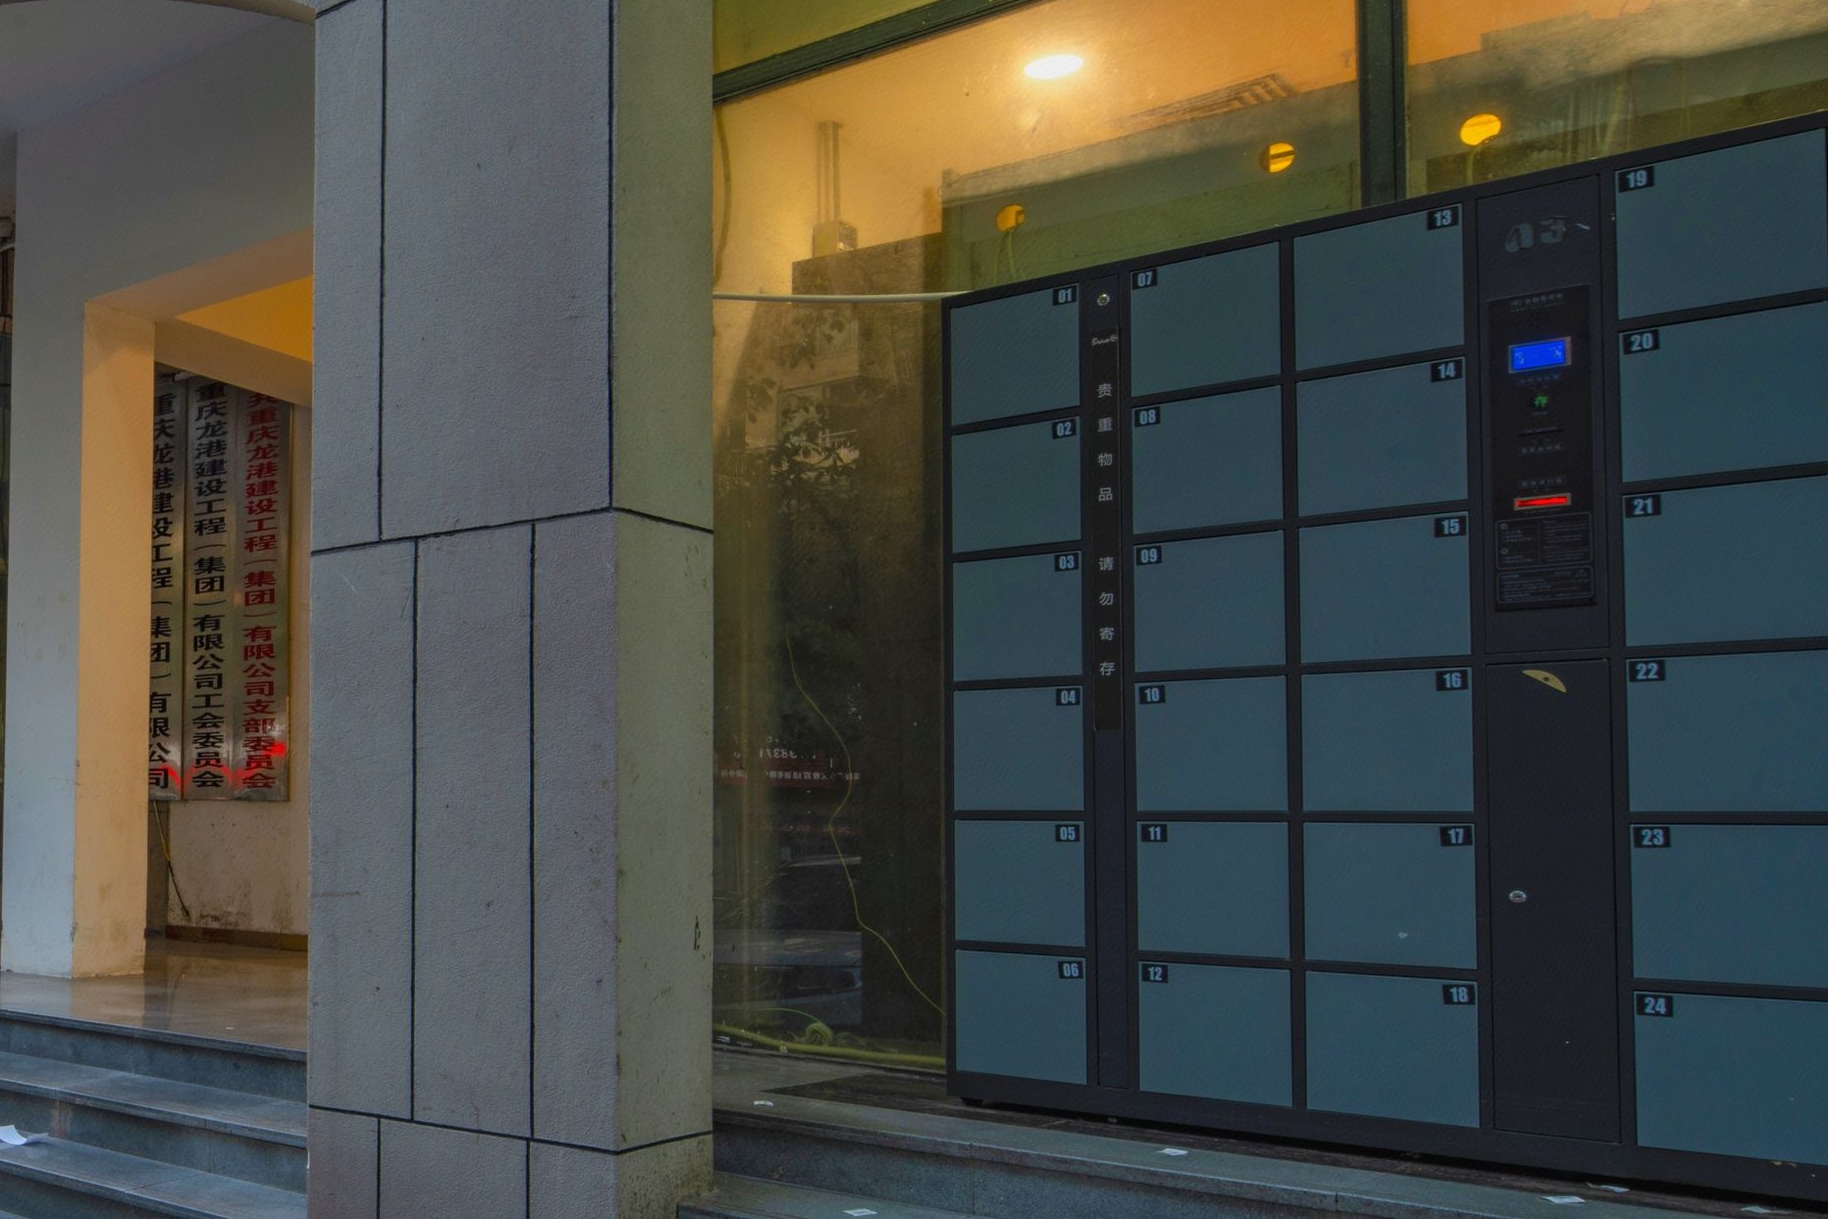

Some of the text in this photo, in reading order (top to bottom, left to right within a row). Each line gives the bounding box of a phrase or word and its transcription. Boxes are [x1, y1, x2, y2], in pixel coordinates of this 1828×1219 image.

[1626, 170, 1648, 188] 19
[1434, 210, 1452, 226] 13
[1137, 272, 1153, 287] 07
[1058, 289, 1073, 303] 01
[1630, 333, 1654, 351] 20
[1437, 363, 1456, 378] 14
[1139, 410, 1156, 424] 08
[1057, 422, 1072, 436] 02
[1633, 497, 1655, 515] 21
[1097, 383, 1115, 676] 贵重物品 请勿寄存
[1442, 519, 1459, 534] 15
[1059, 556, 1074, 570] 03
[1141, 549, 1158, 563] 09
[1635, 663, 1659, 680] 22
[1443, 672, 1461, 689] 16
[1060, 689, 1076, 704] 04
[1144, 688, 1159, 702] 10
[1060, 827, 1075, 841] 05
[1148, 827, 1162, 841] 11
[1447, 829, 1464, 844] 17
[1641, 829, 1664, 846] 23
[1062, 962, 1079, 977] 06
[1148, 966, 1163, 981] 12
[1450, 987, 1468, 1002] 18
[1644, 998, 1668, 1015] 24
